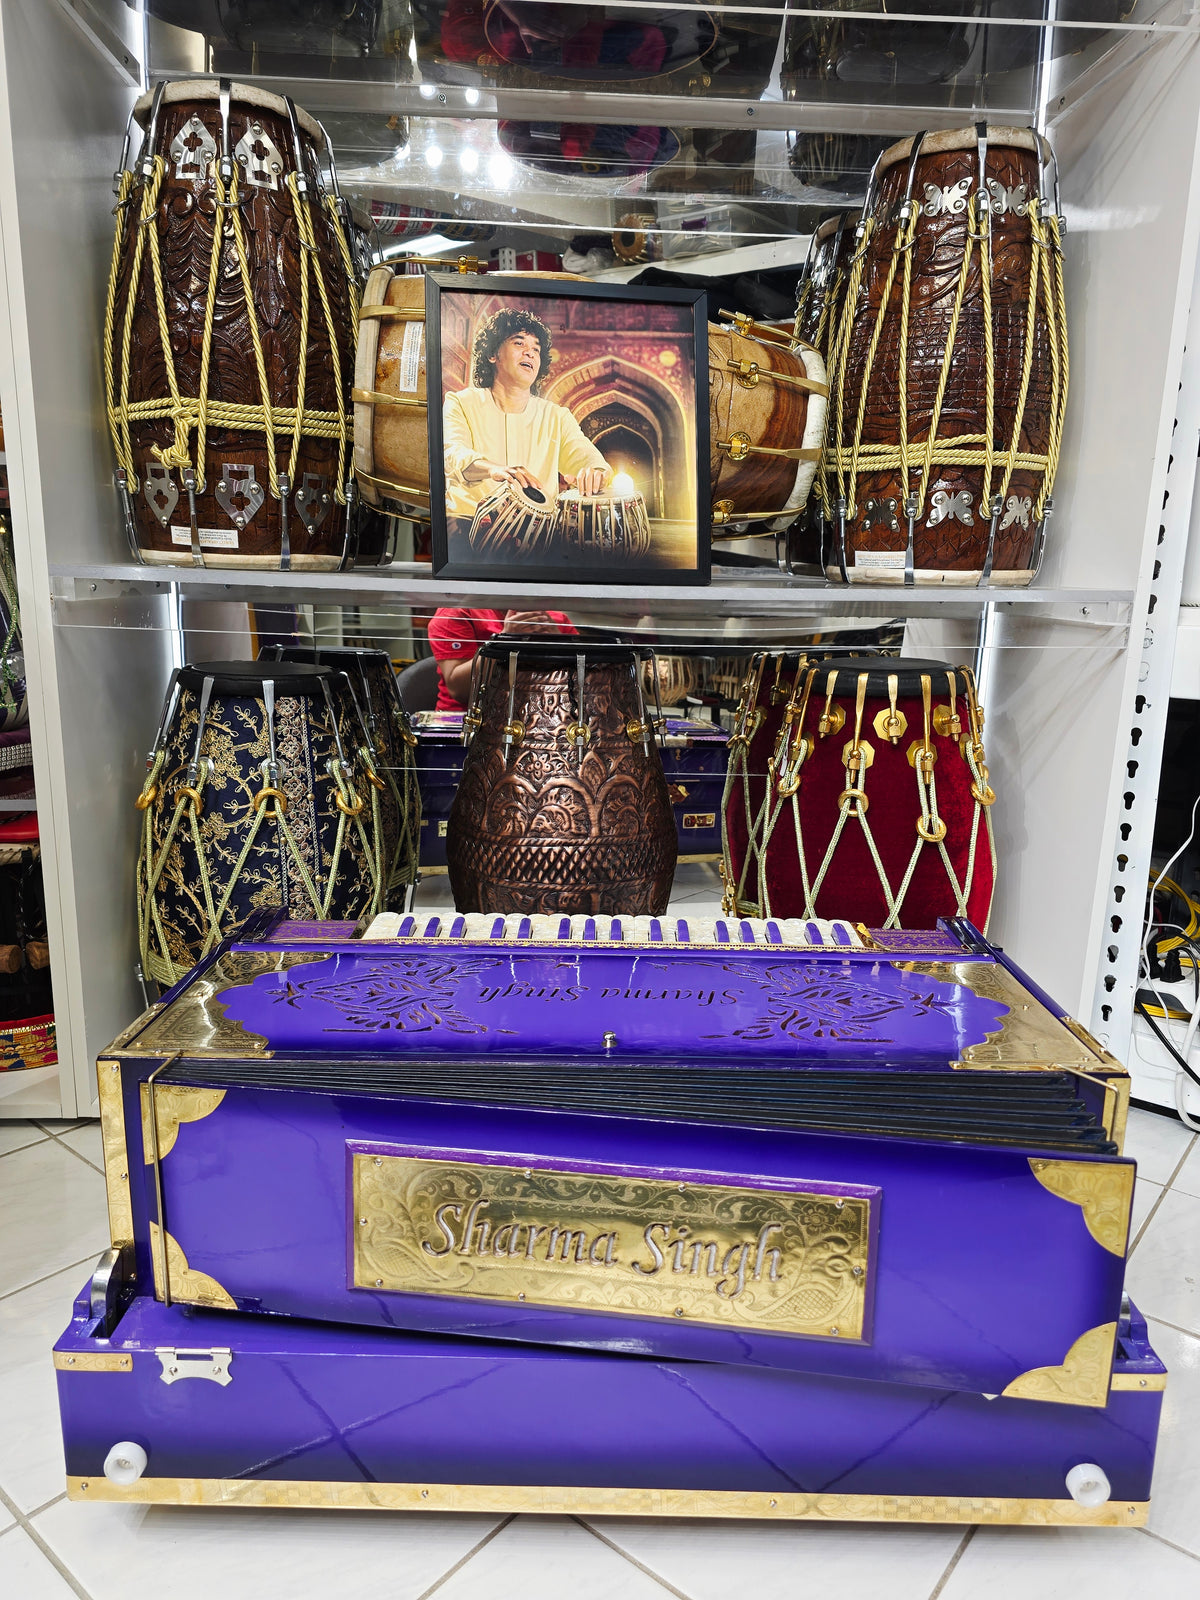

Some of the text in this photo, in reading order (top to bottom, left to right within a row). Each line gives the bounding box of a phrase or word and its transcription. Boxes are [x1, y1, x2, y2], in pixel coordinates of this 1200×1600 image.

[476, 980, 745, 1006] Sharma Singh
[422, 1199, 783, 1299] Sharma Singh
